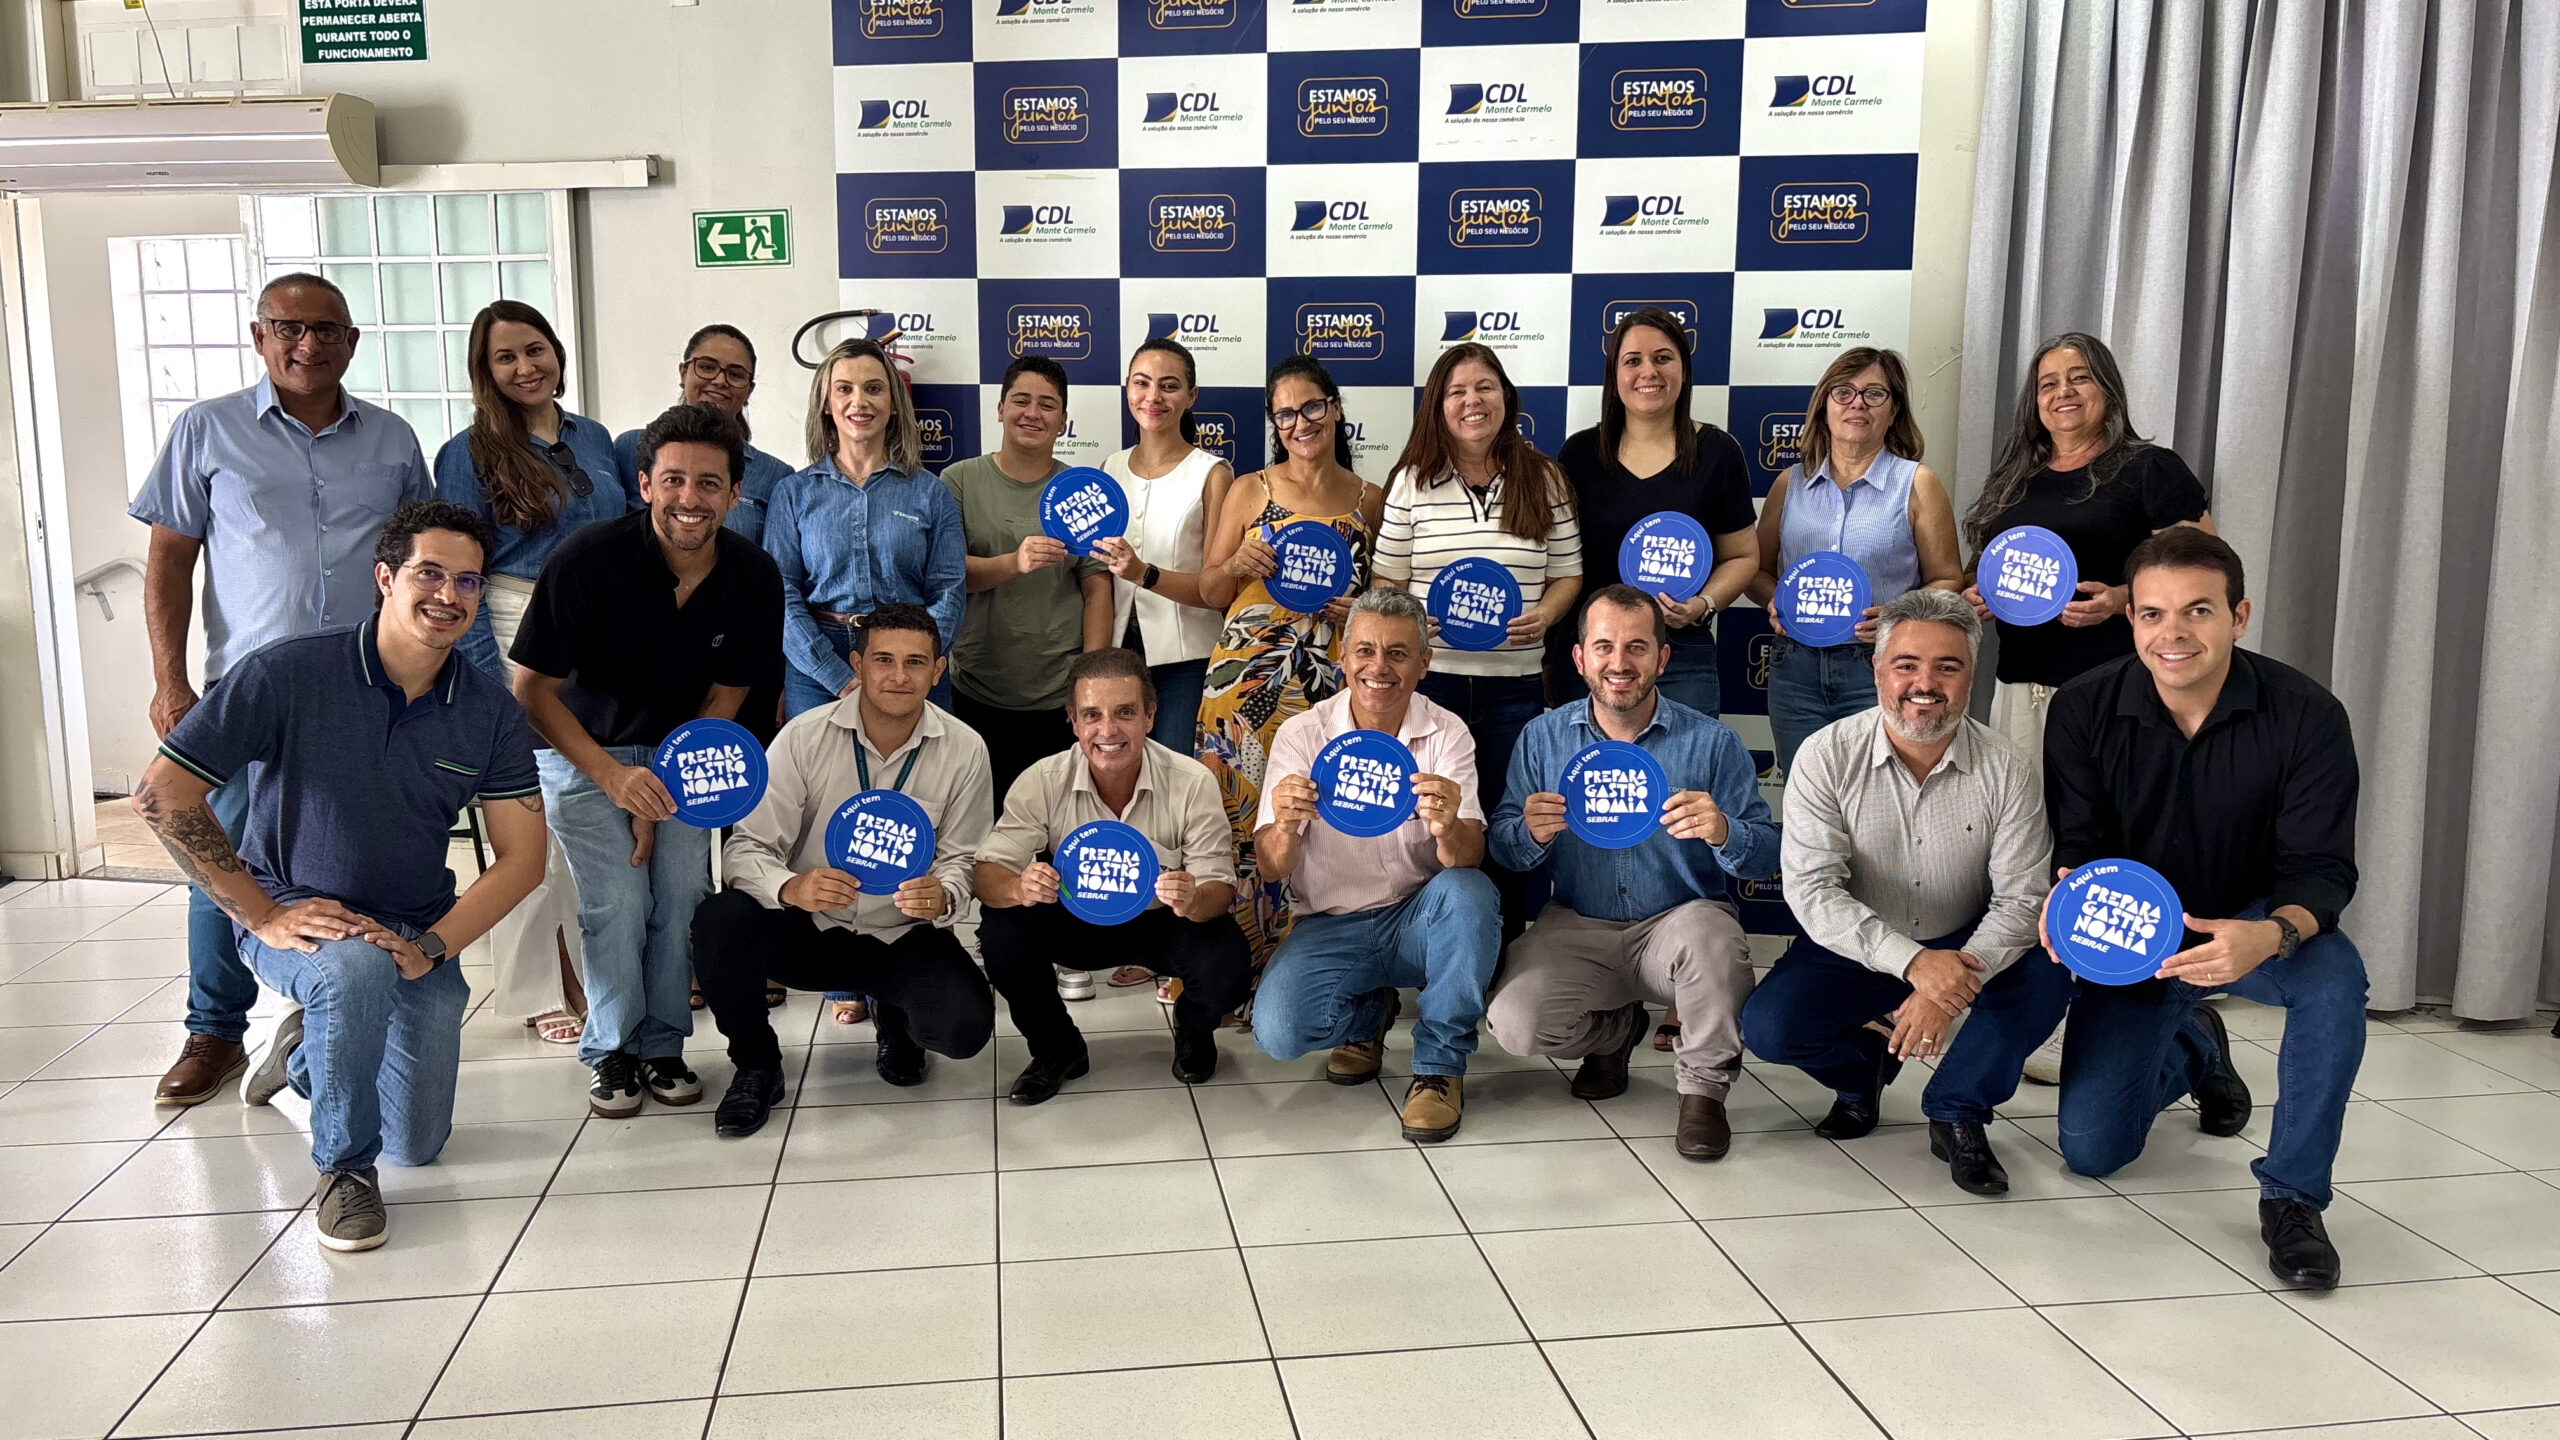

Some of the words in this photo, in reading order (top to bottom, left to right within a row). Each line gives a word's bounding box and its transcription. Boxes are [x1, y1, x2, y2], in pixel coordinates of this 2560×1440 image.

[302, 14, 376, 26] PERMANECER
[379, 13, 422, 24] ABERTA
[315, 31, 367, 43] DURANTE
[370, 30, 400, 41] TODO
[403, 30, 411, 40] O
[318, 47, 413, 59] FUNCIONAMENTO
[1485, 83, 1528, 104] CDL
[1623, 80, 1695, 95] ESTAMOS
[1812, 75, 1856, 96] CDL
[1014, 97, 1077, 111] ESTAMOS
[1180, 92, 1220, 112] CDL
[1309, 88, 1377, 103] ESTAMOS
[1811, 98, 1841, 106] Monte
[1843, 96, 1882, 106] Carmelo
[892, 100, 930, 119] CDL
[1305, 97, 1378, 132] juntos
[1485, 106, 1514, 114] Monte
[1515, 104, 1552, 113] Carmelo
[1618, 88, 1696, 125] juntos
[1647, 109, 1661, 117] SEU
[1663, 107, 1693, 117] NEGÓCIO
[919, 120, 952, 128] Carmelo
[1011, 105, 1079, 139] juntos
[1050, 123, 1077, 131] NEGÓCIO
[1180, 114, 1206, 122] Monte
[1208, 113, 1243, 121] Carmelo
[1347, 115, 1376, 124] NEGÓCIO
[1329, 201, 1369, 221] CDL
[1461, 199, 1530, 213] ESTAMOS
[1641, 195, 1684, 216] CDL
[1783, 194, 1857, 209] ESTAMOS
[1035, 206, 1073, 225] CDL
[1160, 205, 1225, 219] ESTAMOS
[1640, 218, 1670, 226] Monte
[1672, 217, 1709, 225] Carmelo
[1778, 203, 1859, 239] juntos
[1063, 226, 1096, 234] Carmelo
[1156, 213, 1226, 247] juntos
[1329, 223, 1356, 231] Monte
[1358, 222, 1393, 230] Carmelo
[1457, 207, 1532, 243] juntos
[1499, 226, 1529, 235] NEGÓCIO
[1789, 223, 1807, 231] PELO
[1823, 221, 1856, 230] NEGÓCIO
[1197, 231, 1224, 239] NEGÓCIO
[897, 313, 934, 332] CDL
[1180, 314, 1219, 333] CDL
[1307, 314, 1373, 327] ESTAMOS
[1479, 312, 1521, 331] CDL
[1800, 309, 1844, 329] CDL
[1303, 322, 1374, 356] juntos
[1344, 340, 1372, 348] NEGÓCIO
[1479, 333, 1507, 341] Monte
[1509, 332, 1545, 341] Carmelo
[1800, 331, 1829, 339] Monte
[1832, 330, 1870, 339] Carmelo
[1048, 486, 1058, 499] tem
[1054, 482, 1101, 516] PREPARA
[1062, 493, 1107, 524] GASTRO
[1077, 525, 1099, 543] SEBRAE
[1273, 534, 1288, 550] Aqui
[1287, 526, 1303, 536] tem
[1629, 525, 1645, 544] Aqui
[1645, 518, 1661, 528] tem
[1285, 543, 1336, 563] PREPARA
[1643, 535, 1695, 553] PREPARA
[1991, 539, 2009, 556] Aqui
[2008, 532, 2025, 541] tem
[1284, 556, 1335, 575] GASTRO
[1642, 548, 1694, 566] GASTRO
[2004, 549, 2060, 575] PREPARA
[1439, 569, 1455, 586] Aqui
[1456, 563, 1473, 571] tem
[1638, 575, 1666, 583] SEBRAE
[1784, 567, 1799, 586] Aqui
[1799, 559, 1816, 570] tem
[2002, 562, 2058, 587] GASTRO
[1280, 582, 1307, 591] SEBRAE
[1453, 579, 1506, 602] PREPARA
[1799, 577, 1853, 592] PREPARA
[1451, 592, 1504, 613] GASTRO
[1798, 589, 1853, 604] GASTRO
[1995, 590, 2025, 601] SEBRAE
[1446, 619, 1474, 629] SEBRAE
[660, 744, 675, 767] Aqui
[672, 730, 691, 746] tem
[677, 744, 743, 768] PREPARA
[1324, 743, 1343, 763] Aqui
[1342, 736, 1362, 748] tem
[681, 757, 746, 780] GASTRO
[1340, 755, 1401, 781] PREPARA
[1567, 761, 1583, 782] Aqui
[1581, 750, 1600, 762] tem
[1338, 770, 1399, 794] GASTRO
[1584, 769, 1647, 787] PREPARA
[686, 794, 720, 806] SEBRAE
[1585, 784, 1648, 799] GASTRO
[841, 802, 860, 819] Aqui
[861, 795, 881, 804] tem
[1332, 800, 1365, 811] SEBRAE
[856, 813, 916, 841] PREPARA
[1586, 815, 1619, 823] SEBRAE
[854, 827, 913, 855] GASTRO
[1063, 838, 1080, 857] Aqui
[1080, 828, 1098, 839] tem
[846, 856, 878, 869] SEBRAE
[1080, 847, 1140, 865] PREPARA
[1079, 861, 1139, 880] GASTRO
[2069, 873, 2093, 891] Aqui
[2094, 865, 2119, 876] tem
[1077, 892, 1109, 900] SEBRAE
[2085, 884, 2160, 923] PREPARA
[2082, 901, 2156, 939] GASTRO
[2070, 934, 2110, 953] SEBRAE
